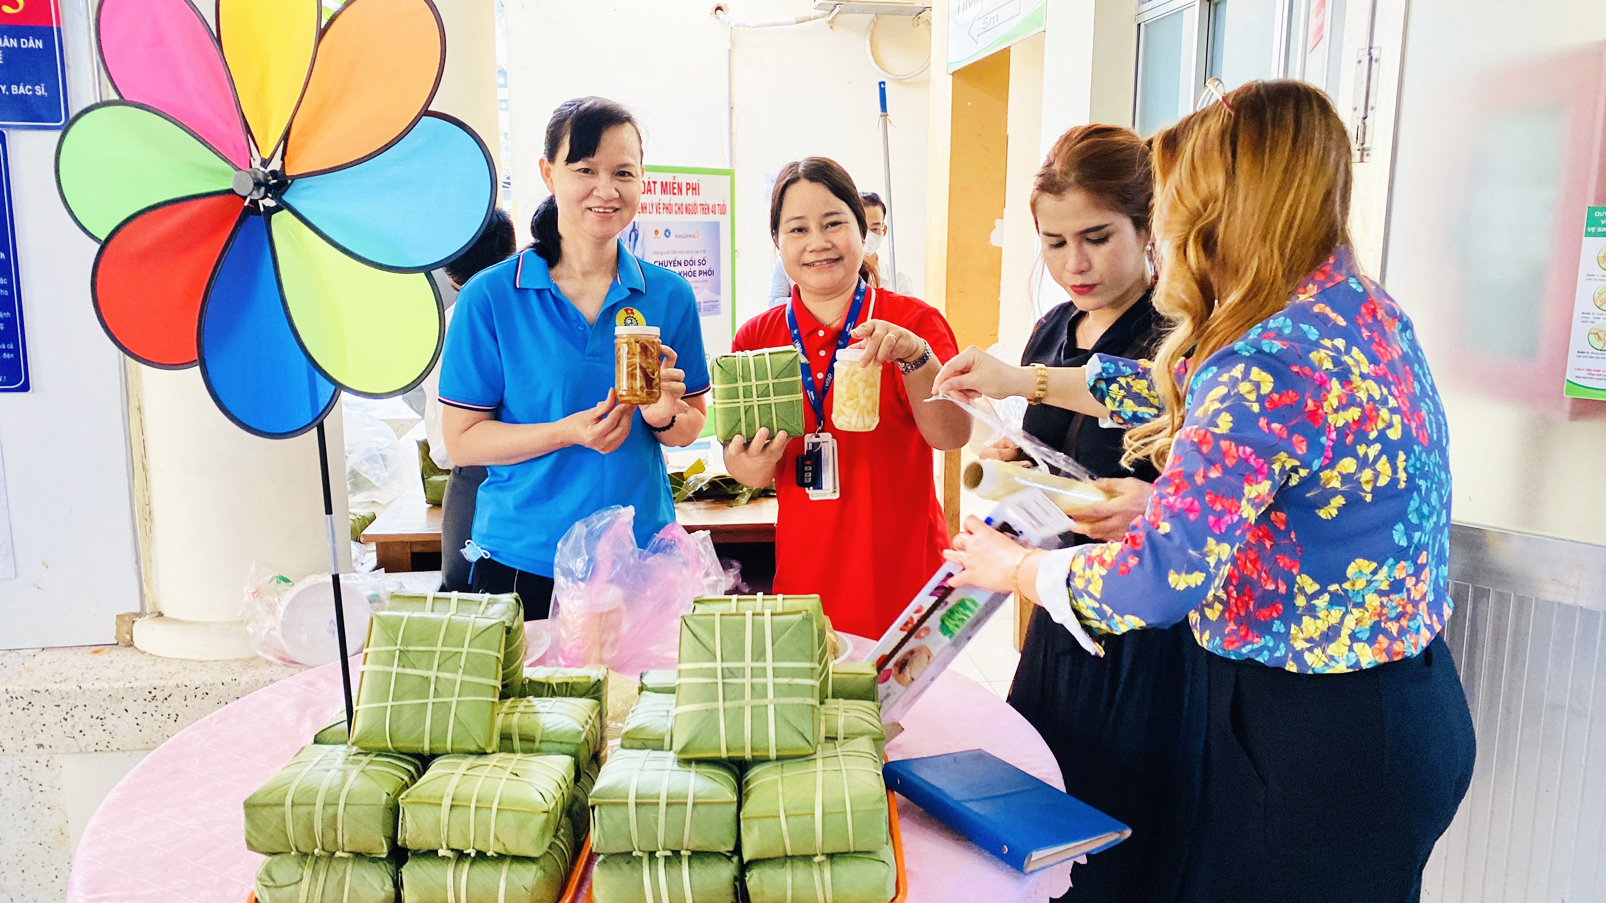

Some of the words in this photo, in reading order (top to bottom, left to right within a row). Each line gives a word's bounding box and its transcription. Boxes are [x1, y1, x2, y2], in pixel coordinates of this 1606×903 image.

[982, 14, 999, 30] 5m
[20, 36, 43, 49] DÂN
[11, 82, 33, 95] BÁC
[35, 83, 48, 97] SĨ,
[660, 175, 683, 196] MIỄN
[685, 178, 701, 196] PHÍ
[674, 202, 684, 215] CHO
[699, 200, 710, 215] TRÊN
[711, 203, 717, 215] 40
[697, 256, 707, 267] SỐ
